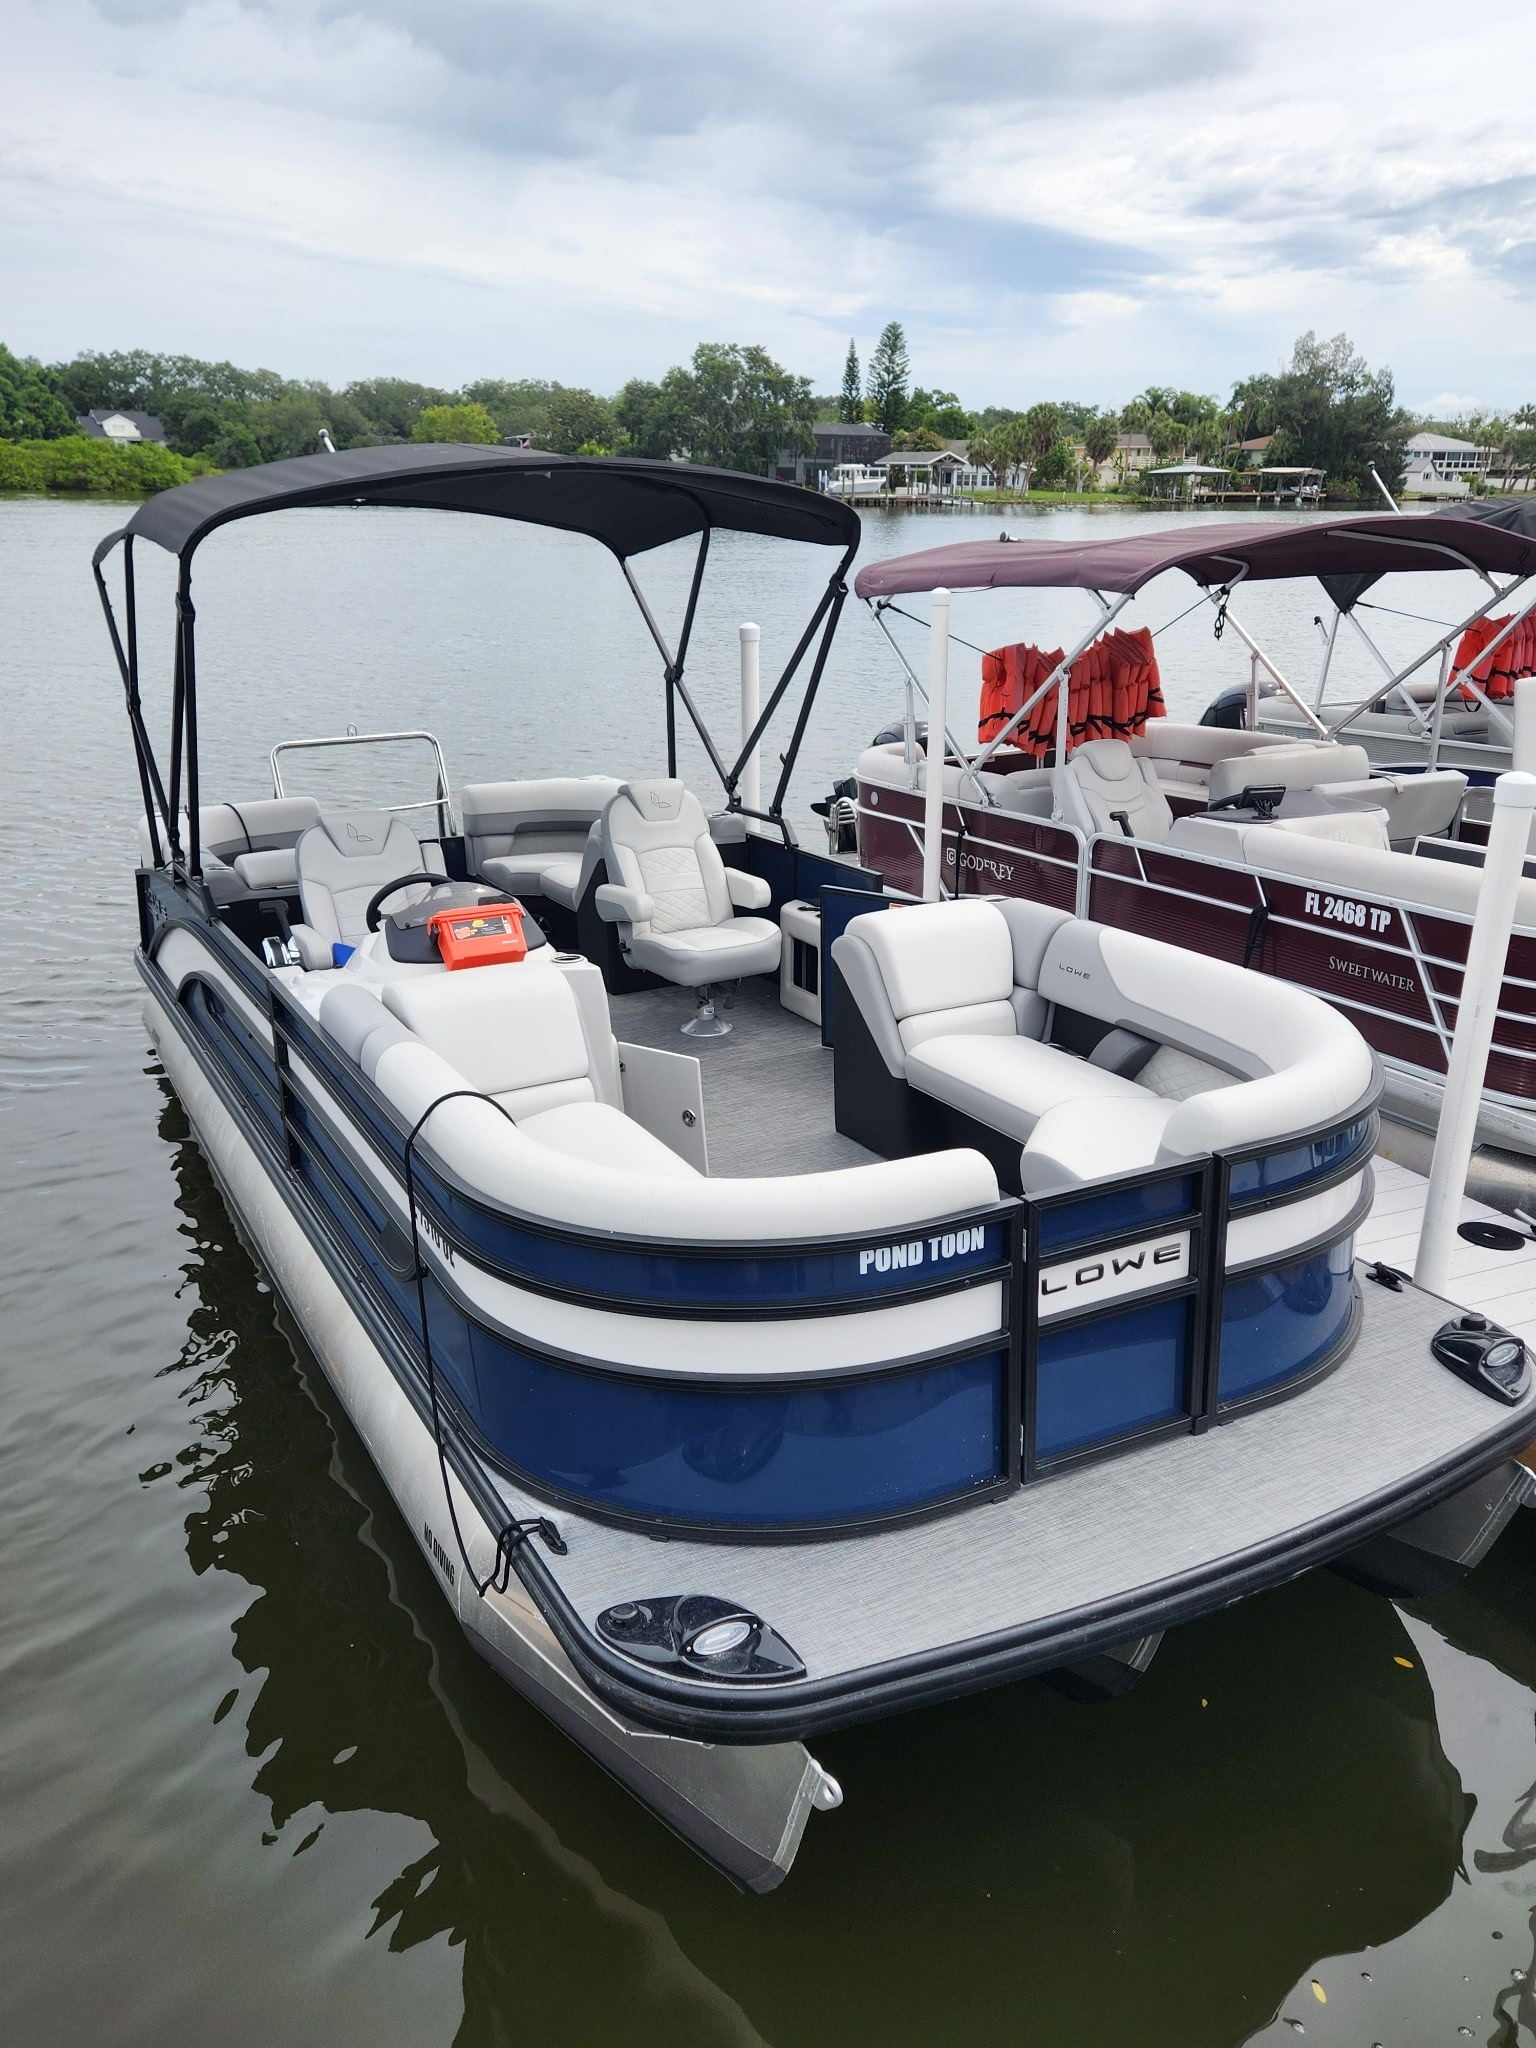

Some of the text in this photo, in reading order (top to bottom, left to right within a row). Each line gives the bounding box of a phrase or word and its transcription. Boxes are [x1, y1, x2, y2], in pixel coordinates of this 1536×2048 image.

[960, 852, 1015, 881] GODFREY
[1305, 891, 1392, 933] FL 2468 TP
[1058, 962, 1091, 980] LOWE
[1328, 955, 1416, 993] SWEETWATER
[859, 1225, 985, 1275] POND TOON
[1041, 1242, 1181, 1296] LOWE
[433, 1536, 455, 1587] DIVING
